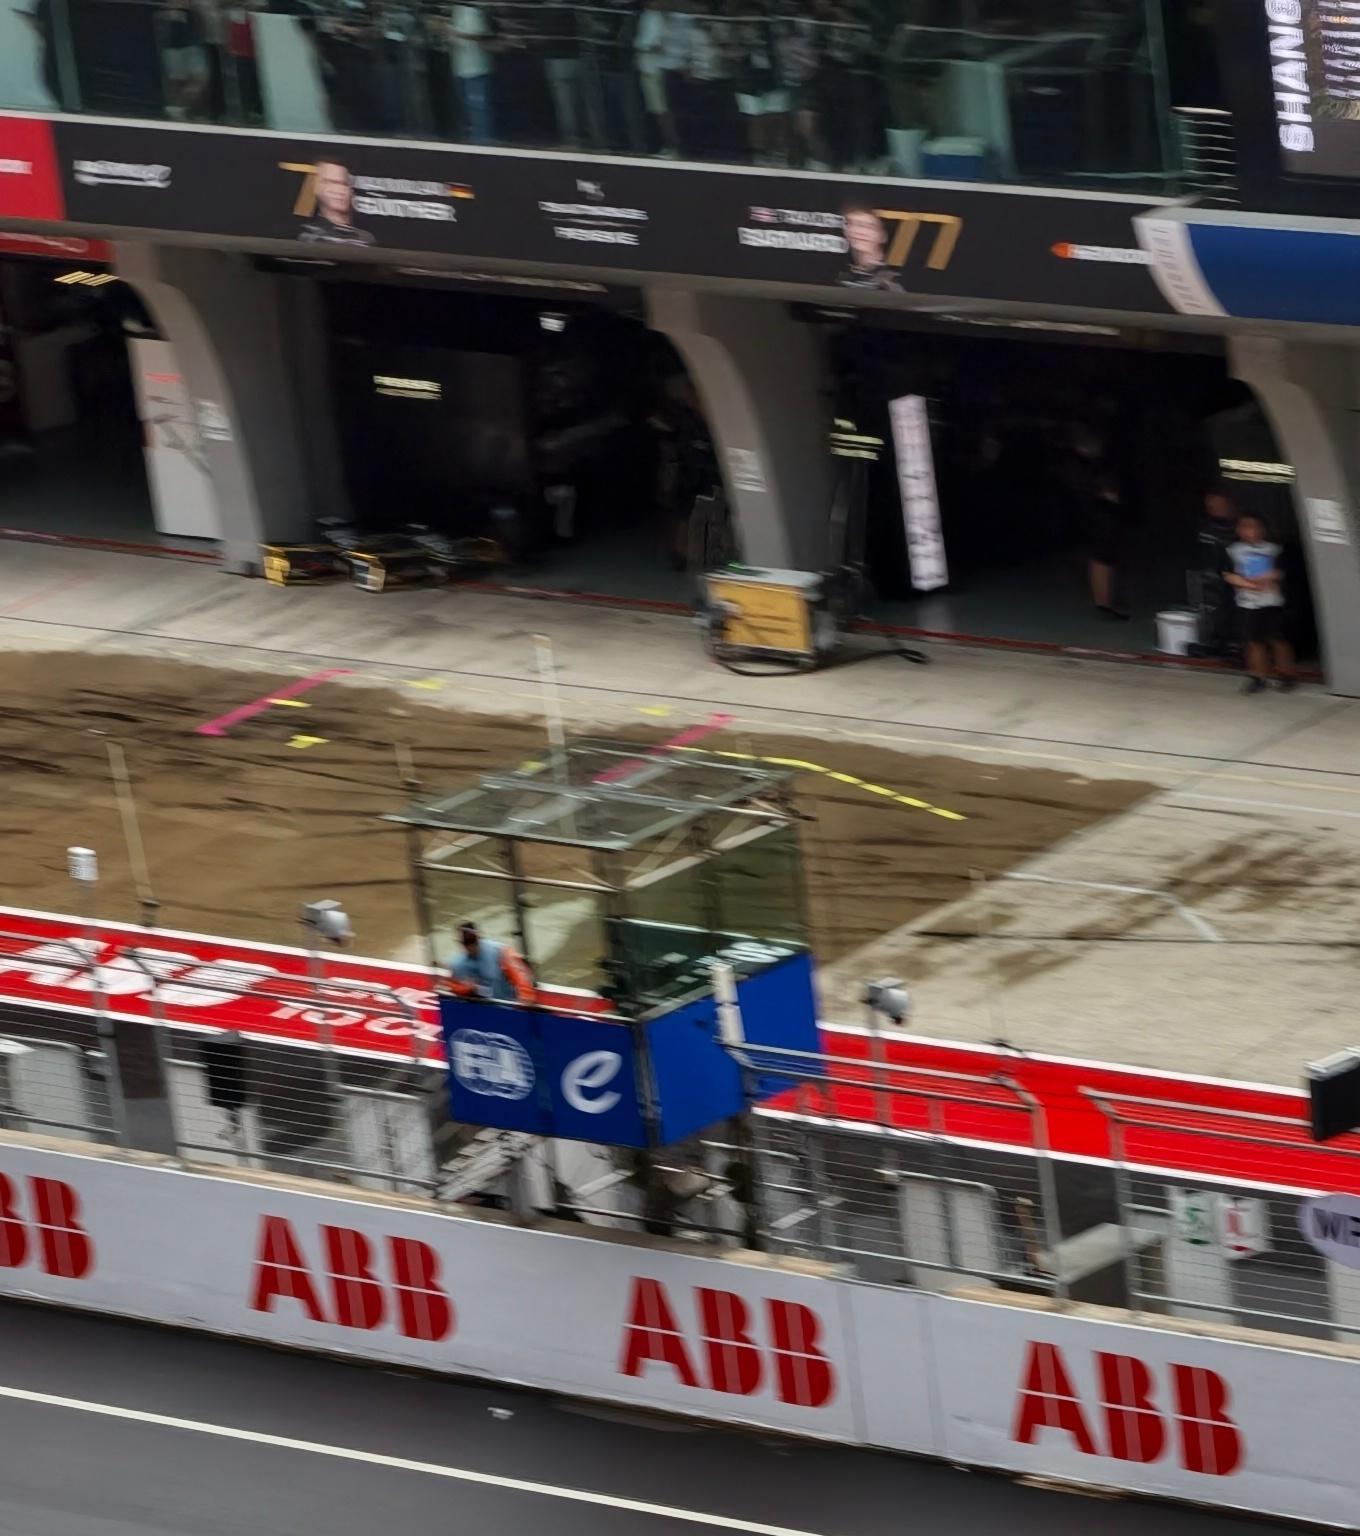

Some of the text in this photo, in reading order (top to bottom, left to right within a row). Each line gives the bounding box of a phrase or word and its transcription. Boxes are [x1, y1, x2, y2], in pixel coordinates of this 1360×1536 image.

[870, 208, 963, 271] 77
[251, 1216, 455, 1342] ABB
[620, 1278, 835, 1408] ABB
[1014, 1341, 1244, 1476] ABB
